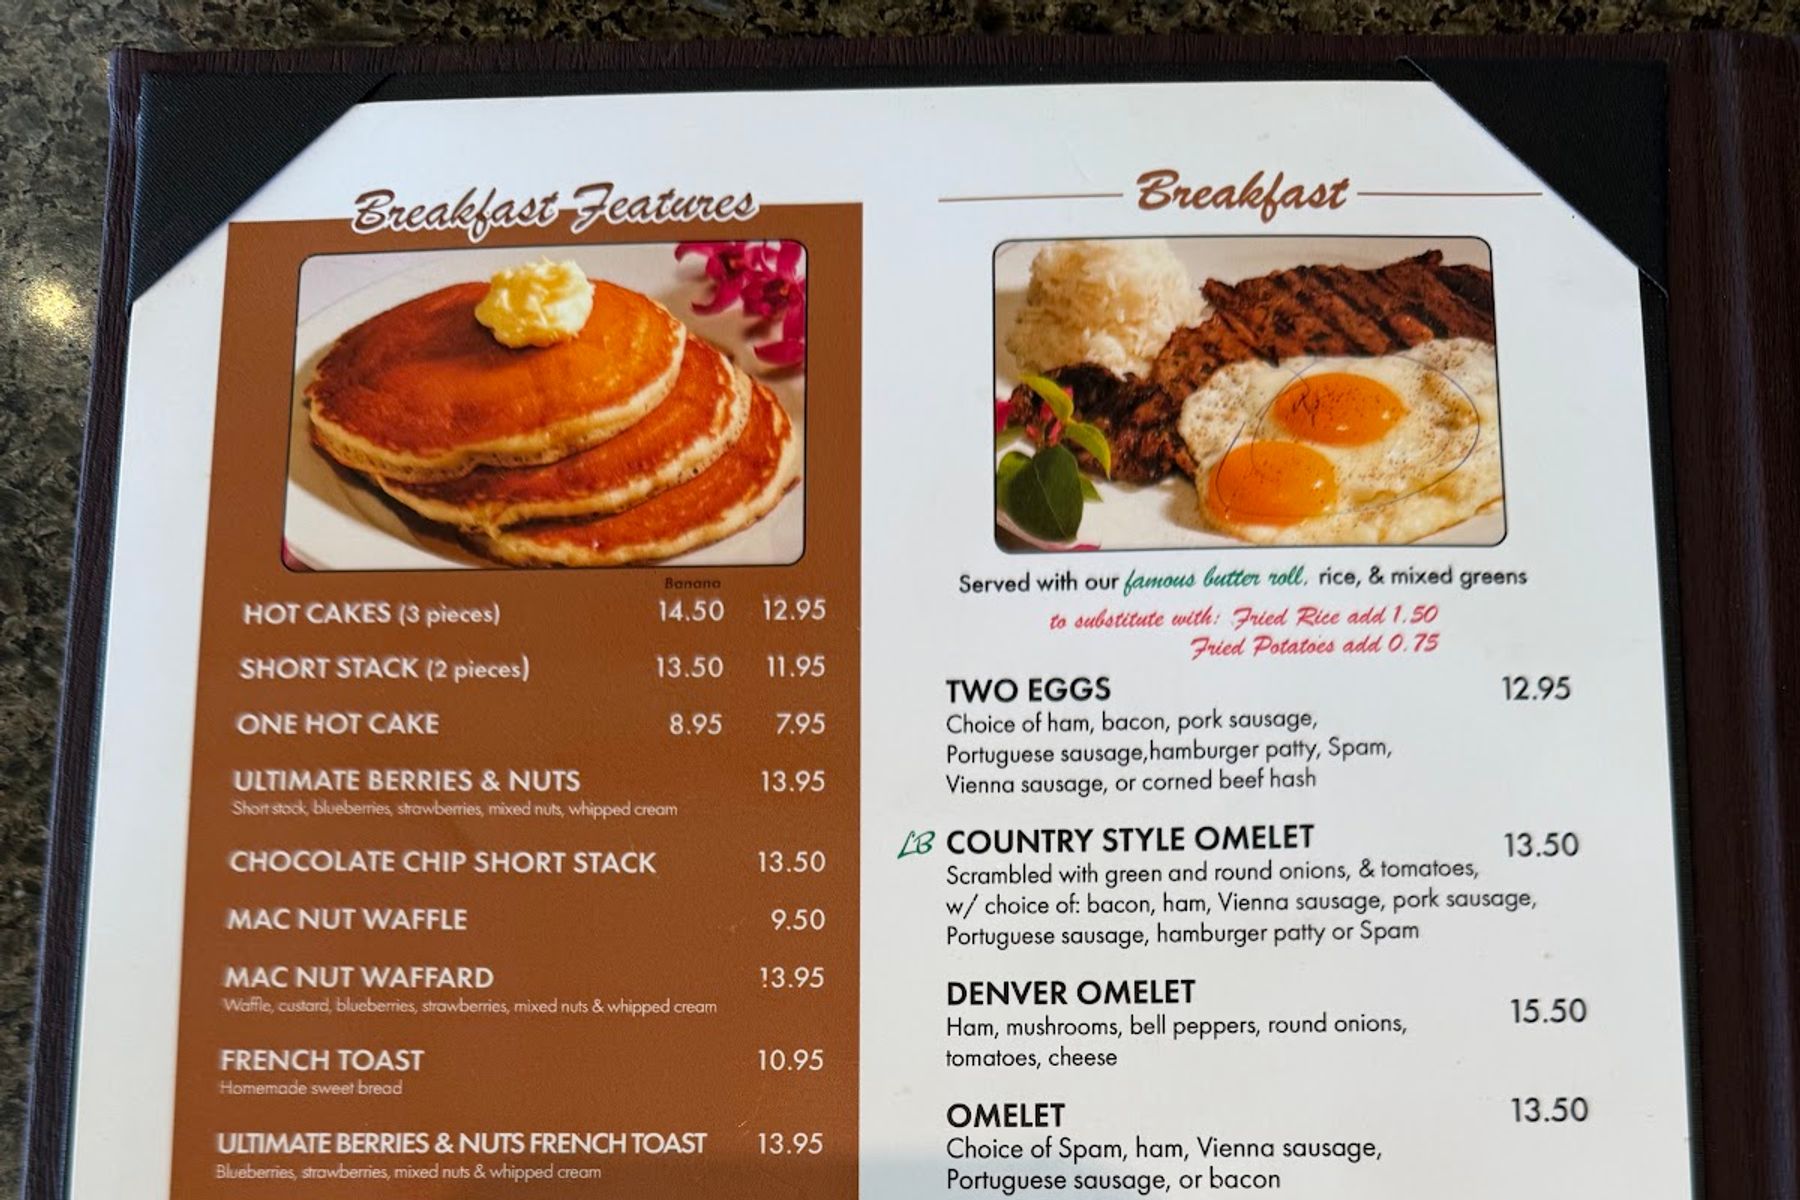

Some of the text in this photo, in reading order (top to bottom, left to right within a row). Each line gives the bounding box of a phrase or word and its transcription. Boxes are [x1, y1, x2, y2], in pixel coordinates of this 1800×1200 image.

[1137, 170, 1350, 224] Breakfast
[353, 182, 756, 241] Breakfast Features
[664, 576, 721, 589] Banana
[959, 572, 1030, 593] Served
[1037, 570, 1077, 591] with
[1085, 577, 1119, 590] our
[1123, 569, 1195, 597] famous
[1203, 566, 1260, 587] butter
[1319, 567, 1361, 587] rice,
[1369, 565, 1384, 584] &
[1391, 566, 1453, 584] mixed
[1460, 572, 1527, 590] greens
[244, 602, 500, 628] HOT CAKES (3 pieces)
[659, 599, 724, 621] 14.50
[764, 598, 825, 620] 12.95
[1191, 633, 1440, 660] Fried Potatoes add 0.75
[240, 655, 529, 683] SHORT STACK (2 pieces)
[657, 656, 723, 678] 13.50
[768, 655, 825, 677] 11.95
[946, 677, 1110, 703] TWO EGGS
[1503, 676, 1570, 700] 12.95
[236, 712, 439, 735] ONE HOT CAKE
[670, 713, 722, 735] 8.95
[777, 712, 825, 734] 7.95
[947, 708, 1316, 735] Choice of ham, bacon, pork sausage,
[234, 769, 580, 791] ULTIMATE BERRIES & NUTS
[762, 770, 824, 792] 13.95
[947, 824, 1314, 854] COUNTRY STYLE OMELET
[1505, 832, 1579, 857] 13.50
[229, 850, 656, 873] CHOCOLATE CHIP SHORT STACK
[759, 851, 825, 872] 13.50
[227, 908, 467, 930] MAC NUT WAFFLE
[771, 909, 825, 930] 9.50
[225, 966, 494, 988] MAC NUT WAFFARD
[948, 980, 1195, 1005] DENVER OMELET
[1511, 998, 1587, 1023] 15.50
[221, 1049, 425, 1071] FRENCH TOAST
[759, 1049, 823, 1070] 10.95
[220, 1080, 402, 1094] Homemade sweet bread
[947, 1103, 1065, 1127] OMELET
[1512, 1097, 1588, 1122] 13.50
